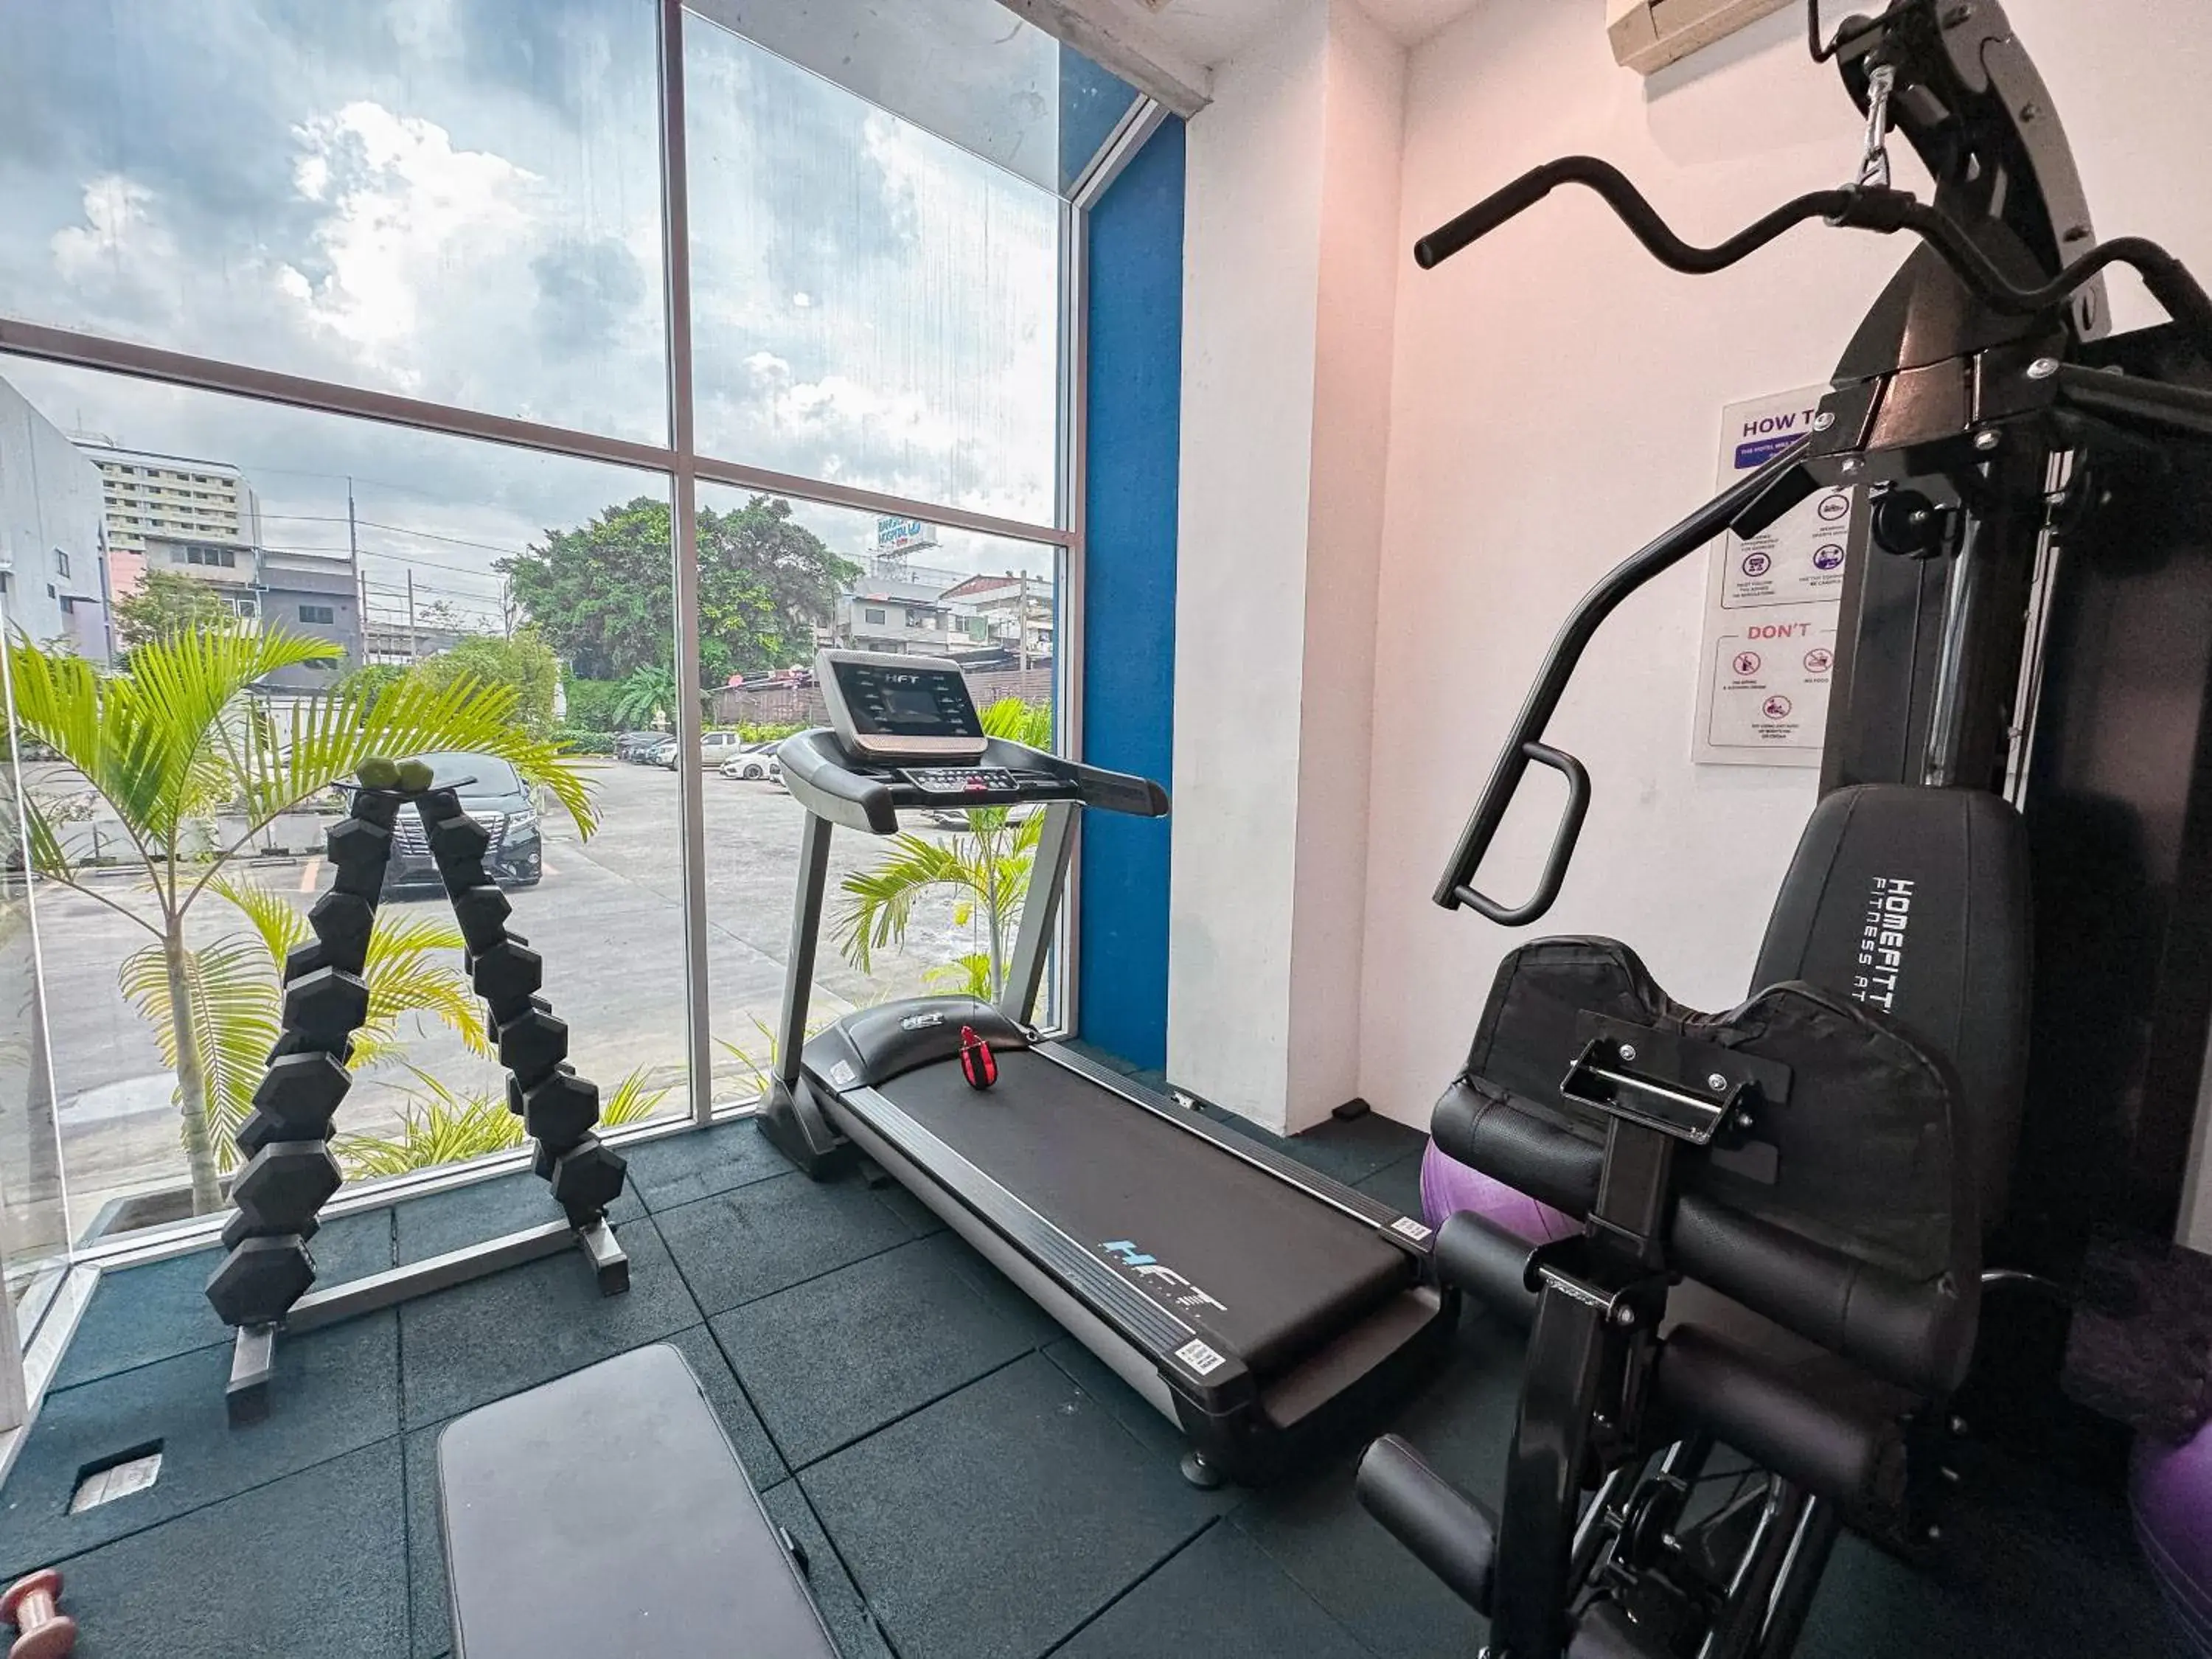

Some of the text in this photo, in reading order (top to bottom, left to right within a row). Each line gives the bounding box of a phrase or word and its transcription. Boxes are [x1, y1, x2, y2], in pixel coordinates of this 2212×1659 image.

[1743, 409, 1815, 437] HOW T
[1747, 623, 1812, 639] DON'T
[886, 674, 920, 684] HFT
[1851, 877, 1887, 1002] FITNESS AT
[1870, 878, 1915, 1014] HOMEFITT
[1102, 1240, 1228, 1312] HFT
